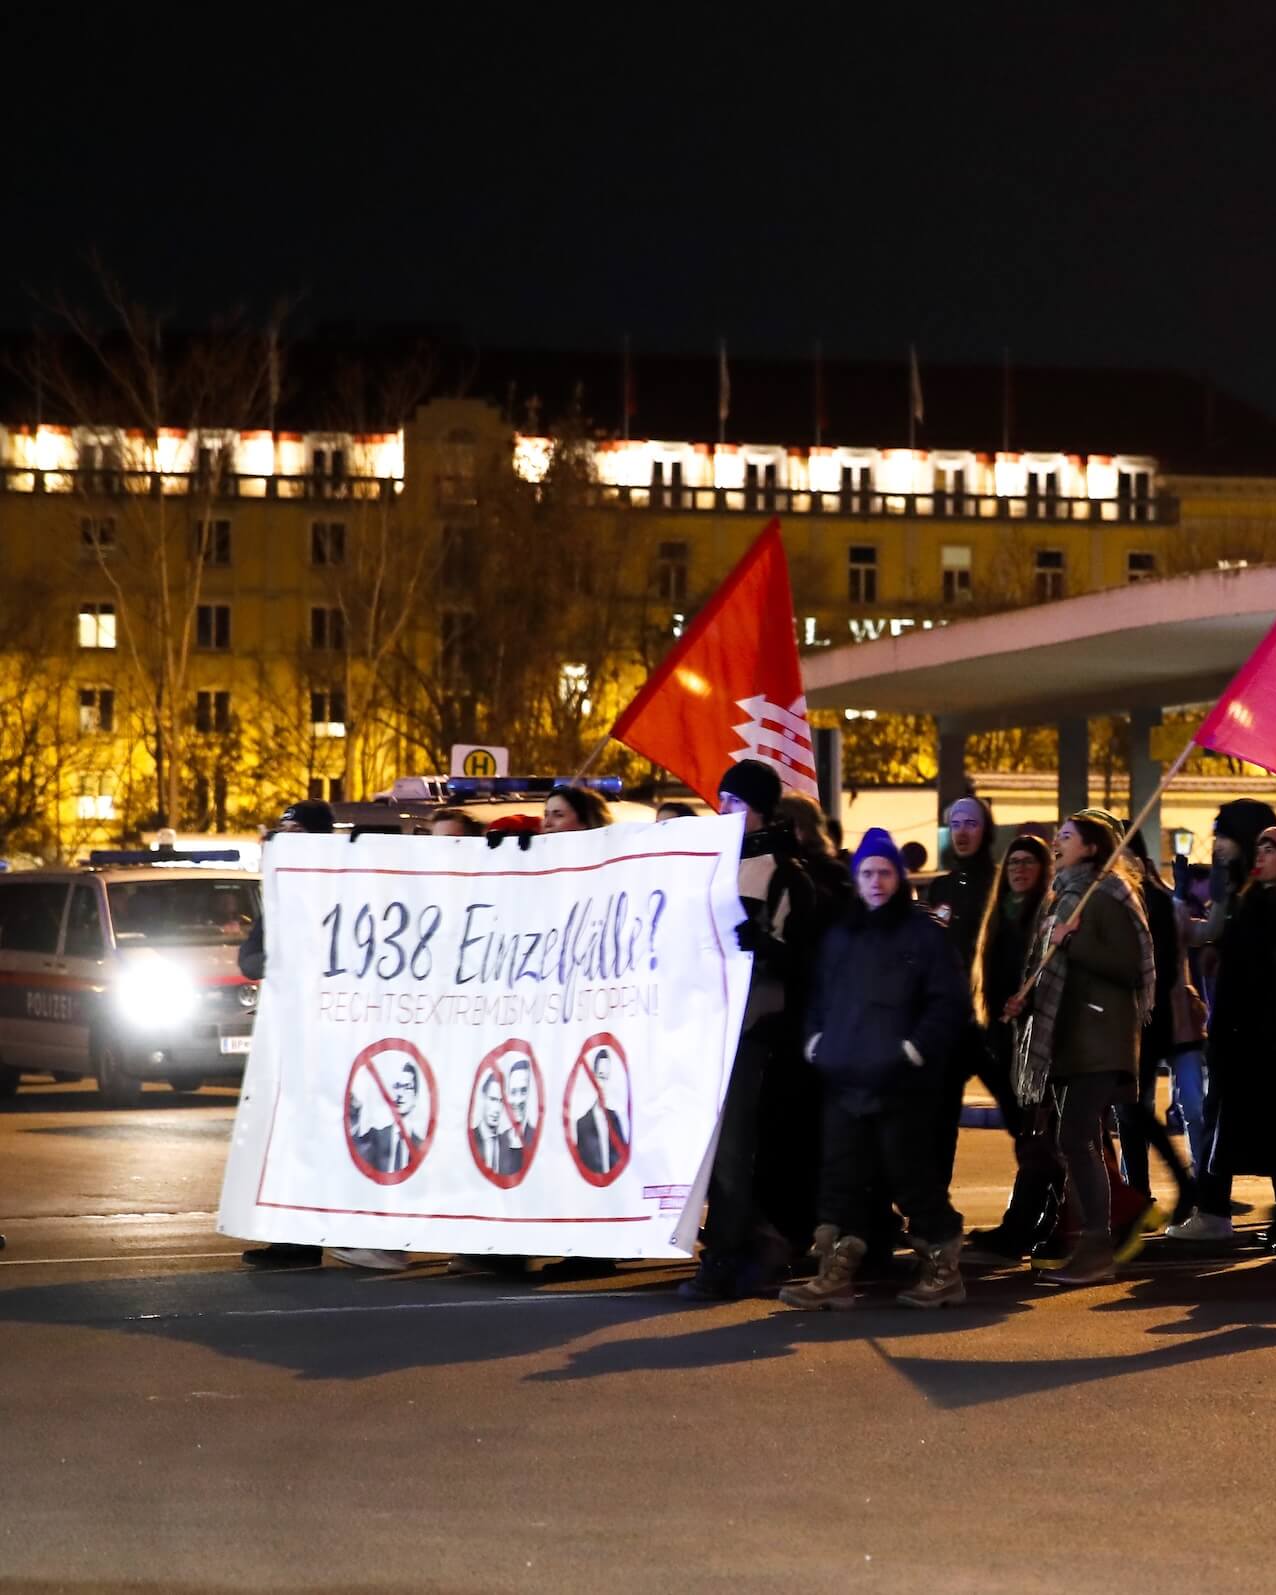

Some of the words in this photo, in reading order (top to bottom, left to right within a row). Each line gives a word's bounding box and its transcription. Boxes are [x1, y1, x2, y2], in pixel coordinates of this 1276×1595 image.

[472, 755, 488, 775] H
[321, 901, 442, 981] 1938
[455, 888, 667, 1024] Einzelfälle?
[26, 991, 73, 1019] POLIZEI
[319, 989, 562, 1026] RECHTSEXTREMISMUS
